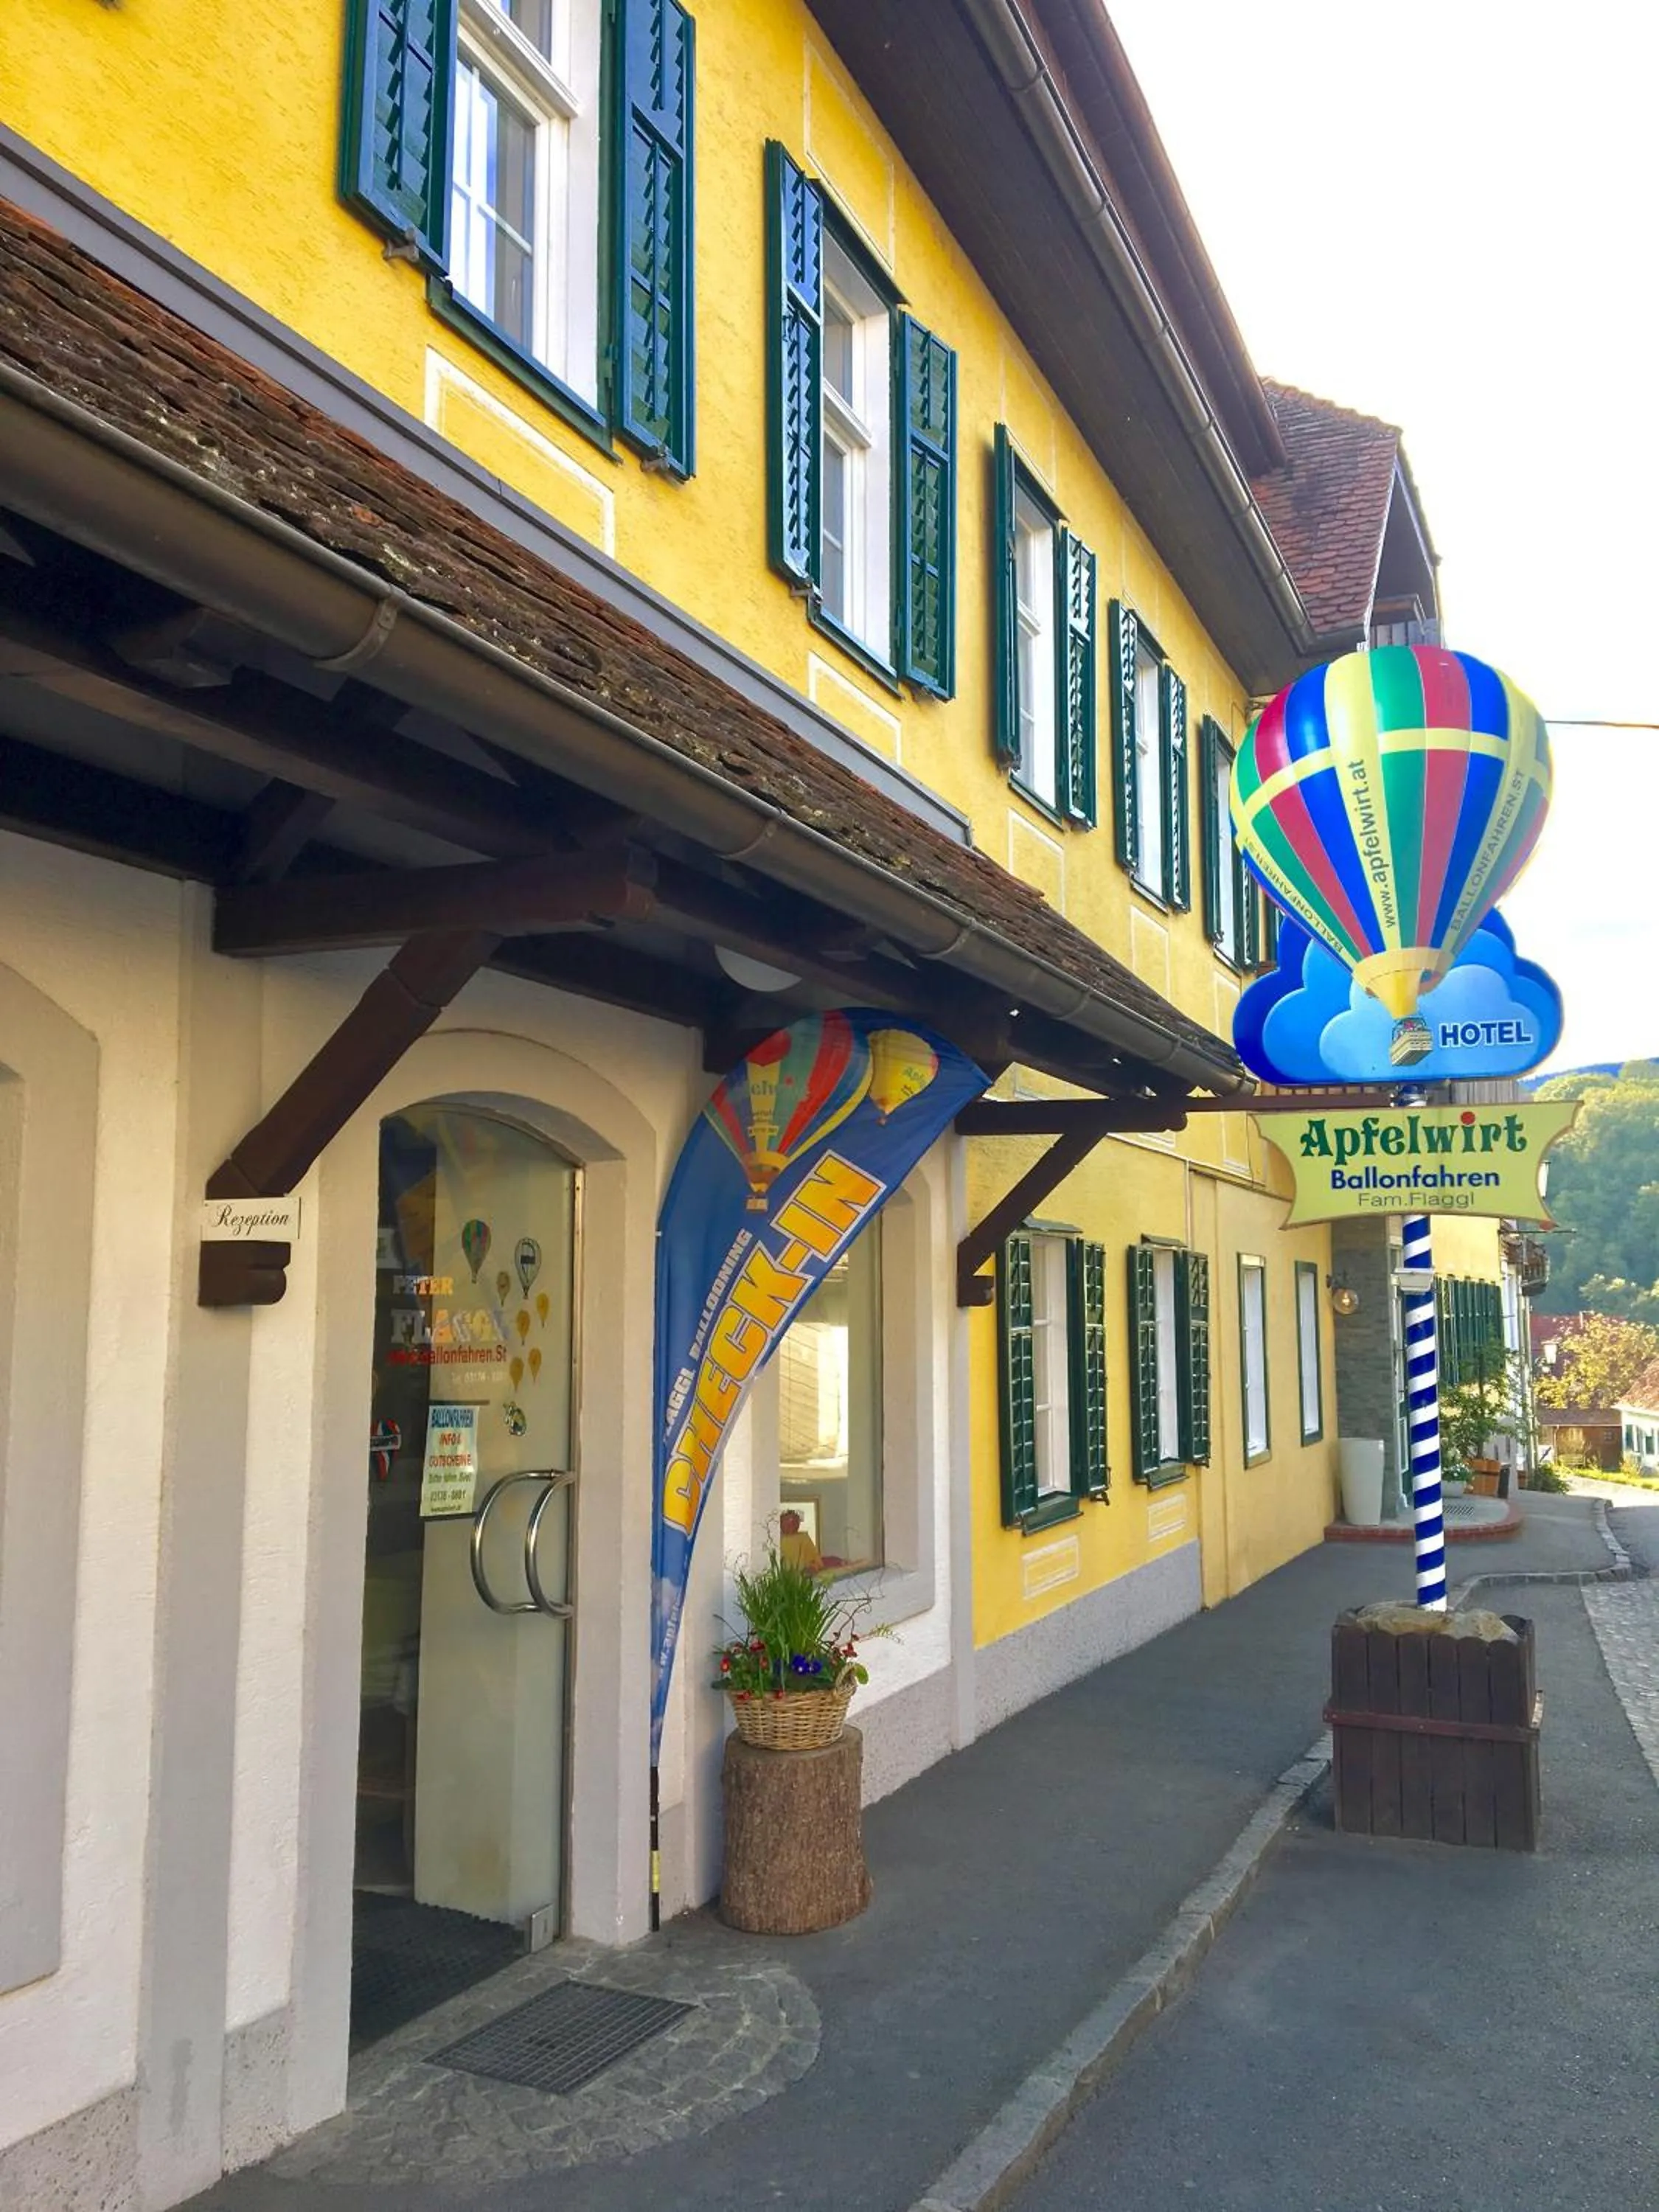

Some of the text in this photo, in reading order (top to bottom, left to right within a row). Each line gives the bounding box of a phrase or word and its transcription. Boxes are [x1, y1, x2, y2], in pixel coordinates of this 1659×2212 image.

[1347, 759, 1396, 928] www.apfelwirt.at
[1450, 768, 1525, 933] BALLONFAHREN.ST
[1440, 1020, 1532, 1047] HOTEL
[1300, 1110, 1528, 1166] Apfelwirt
[1330, 1165, 1500, 1189] Ballonfahren
[212, 1203, 291, 1236] Rezeption
[689, 1228, 754, 1362] BALLOONING
[661, 1151, 886, 1538] CHECK-IN
